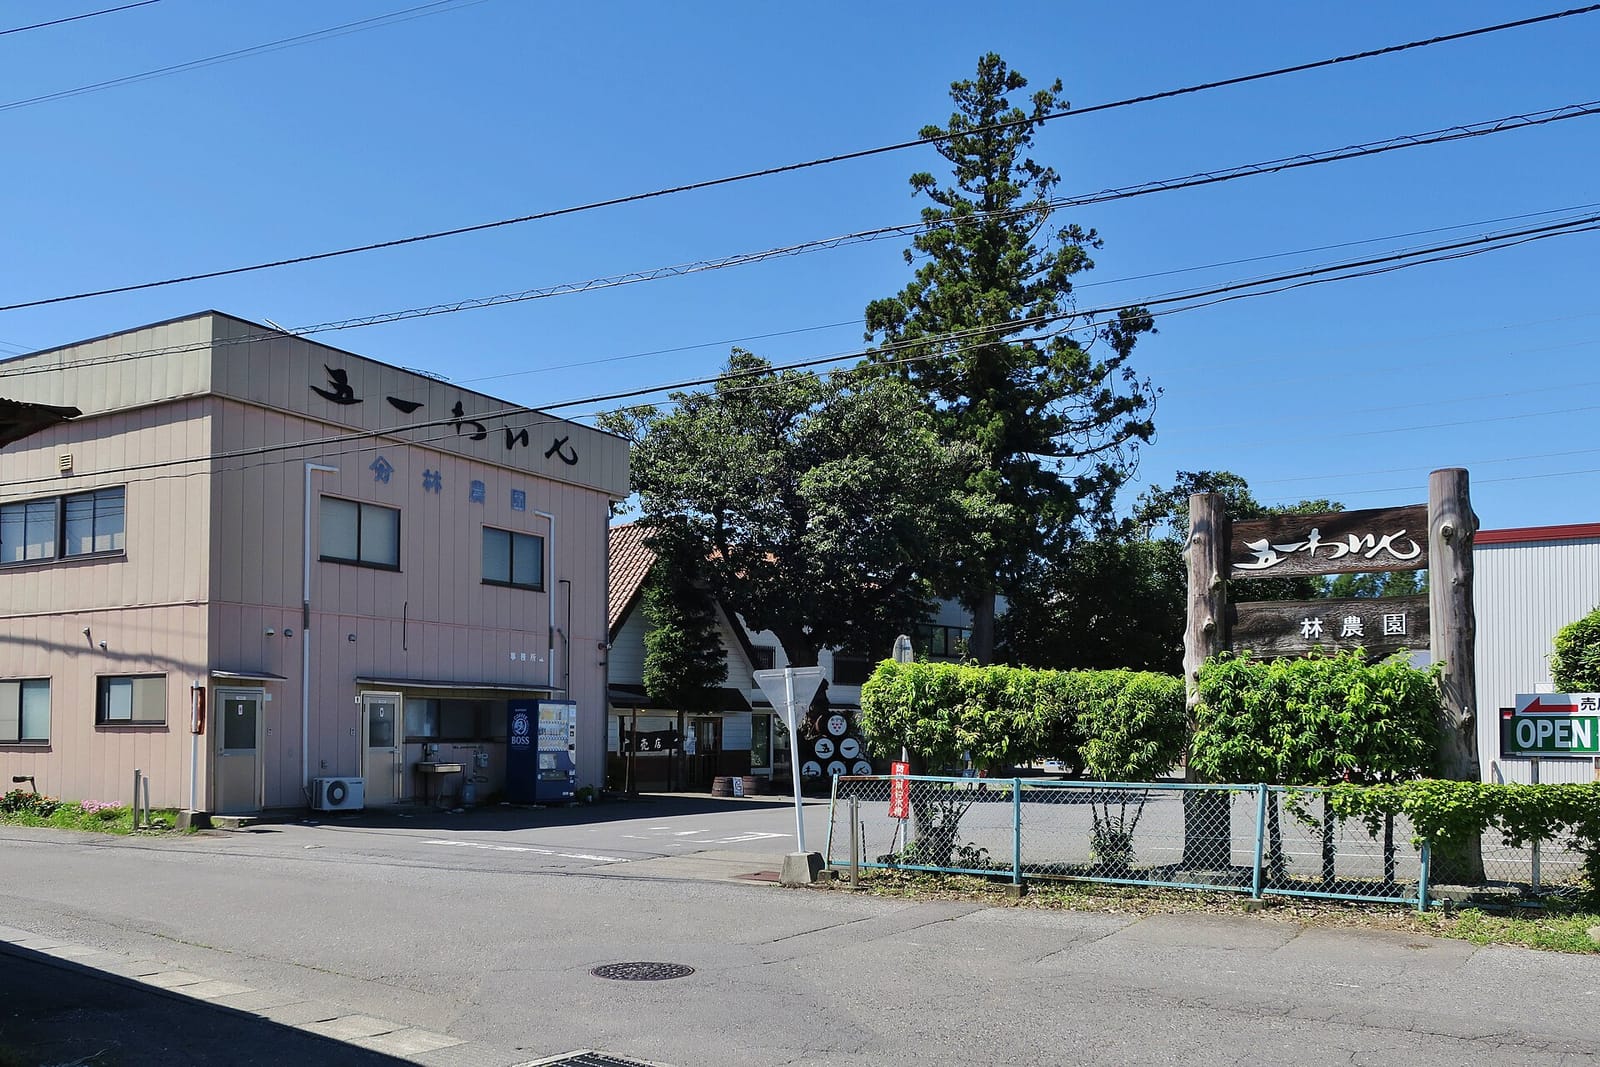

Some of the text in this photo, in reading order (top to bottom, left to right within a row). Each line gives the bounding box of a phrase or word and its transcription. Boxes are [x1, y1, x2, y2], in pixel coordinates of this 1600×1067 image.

[310, 364, 578, 466] 五一わいん
[1232, 527, 1421, 570] 五一わいん
[1300, 612, 1407, 640] 林農園
[511, 736, 530, 745] BOSS
[640, 738, 663, 751] 売店
[1516, 718, 1591, 749] OPEN
